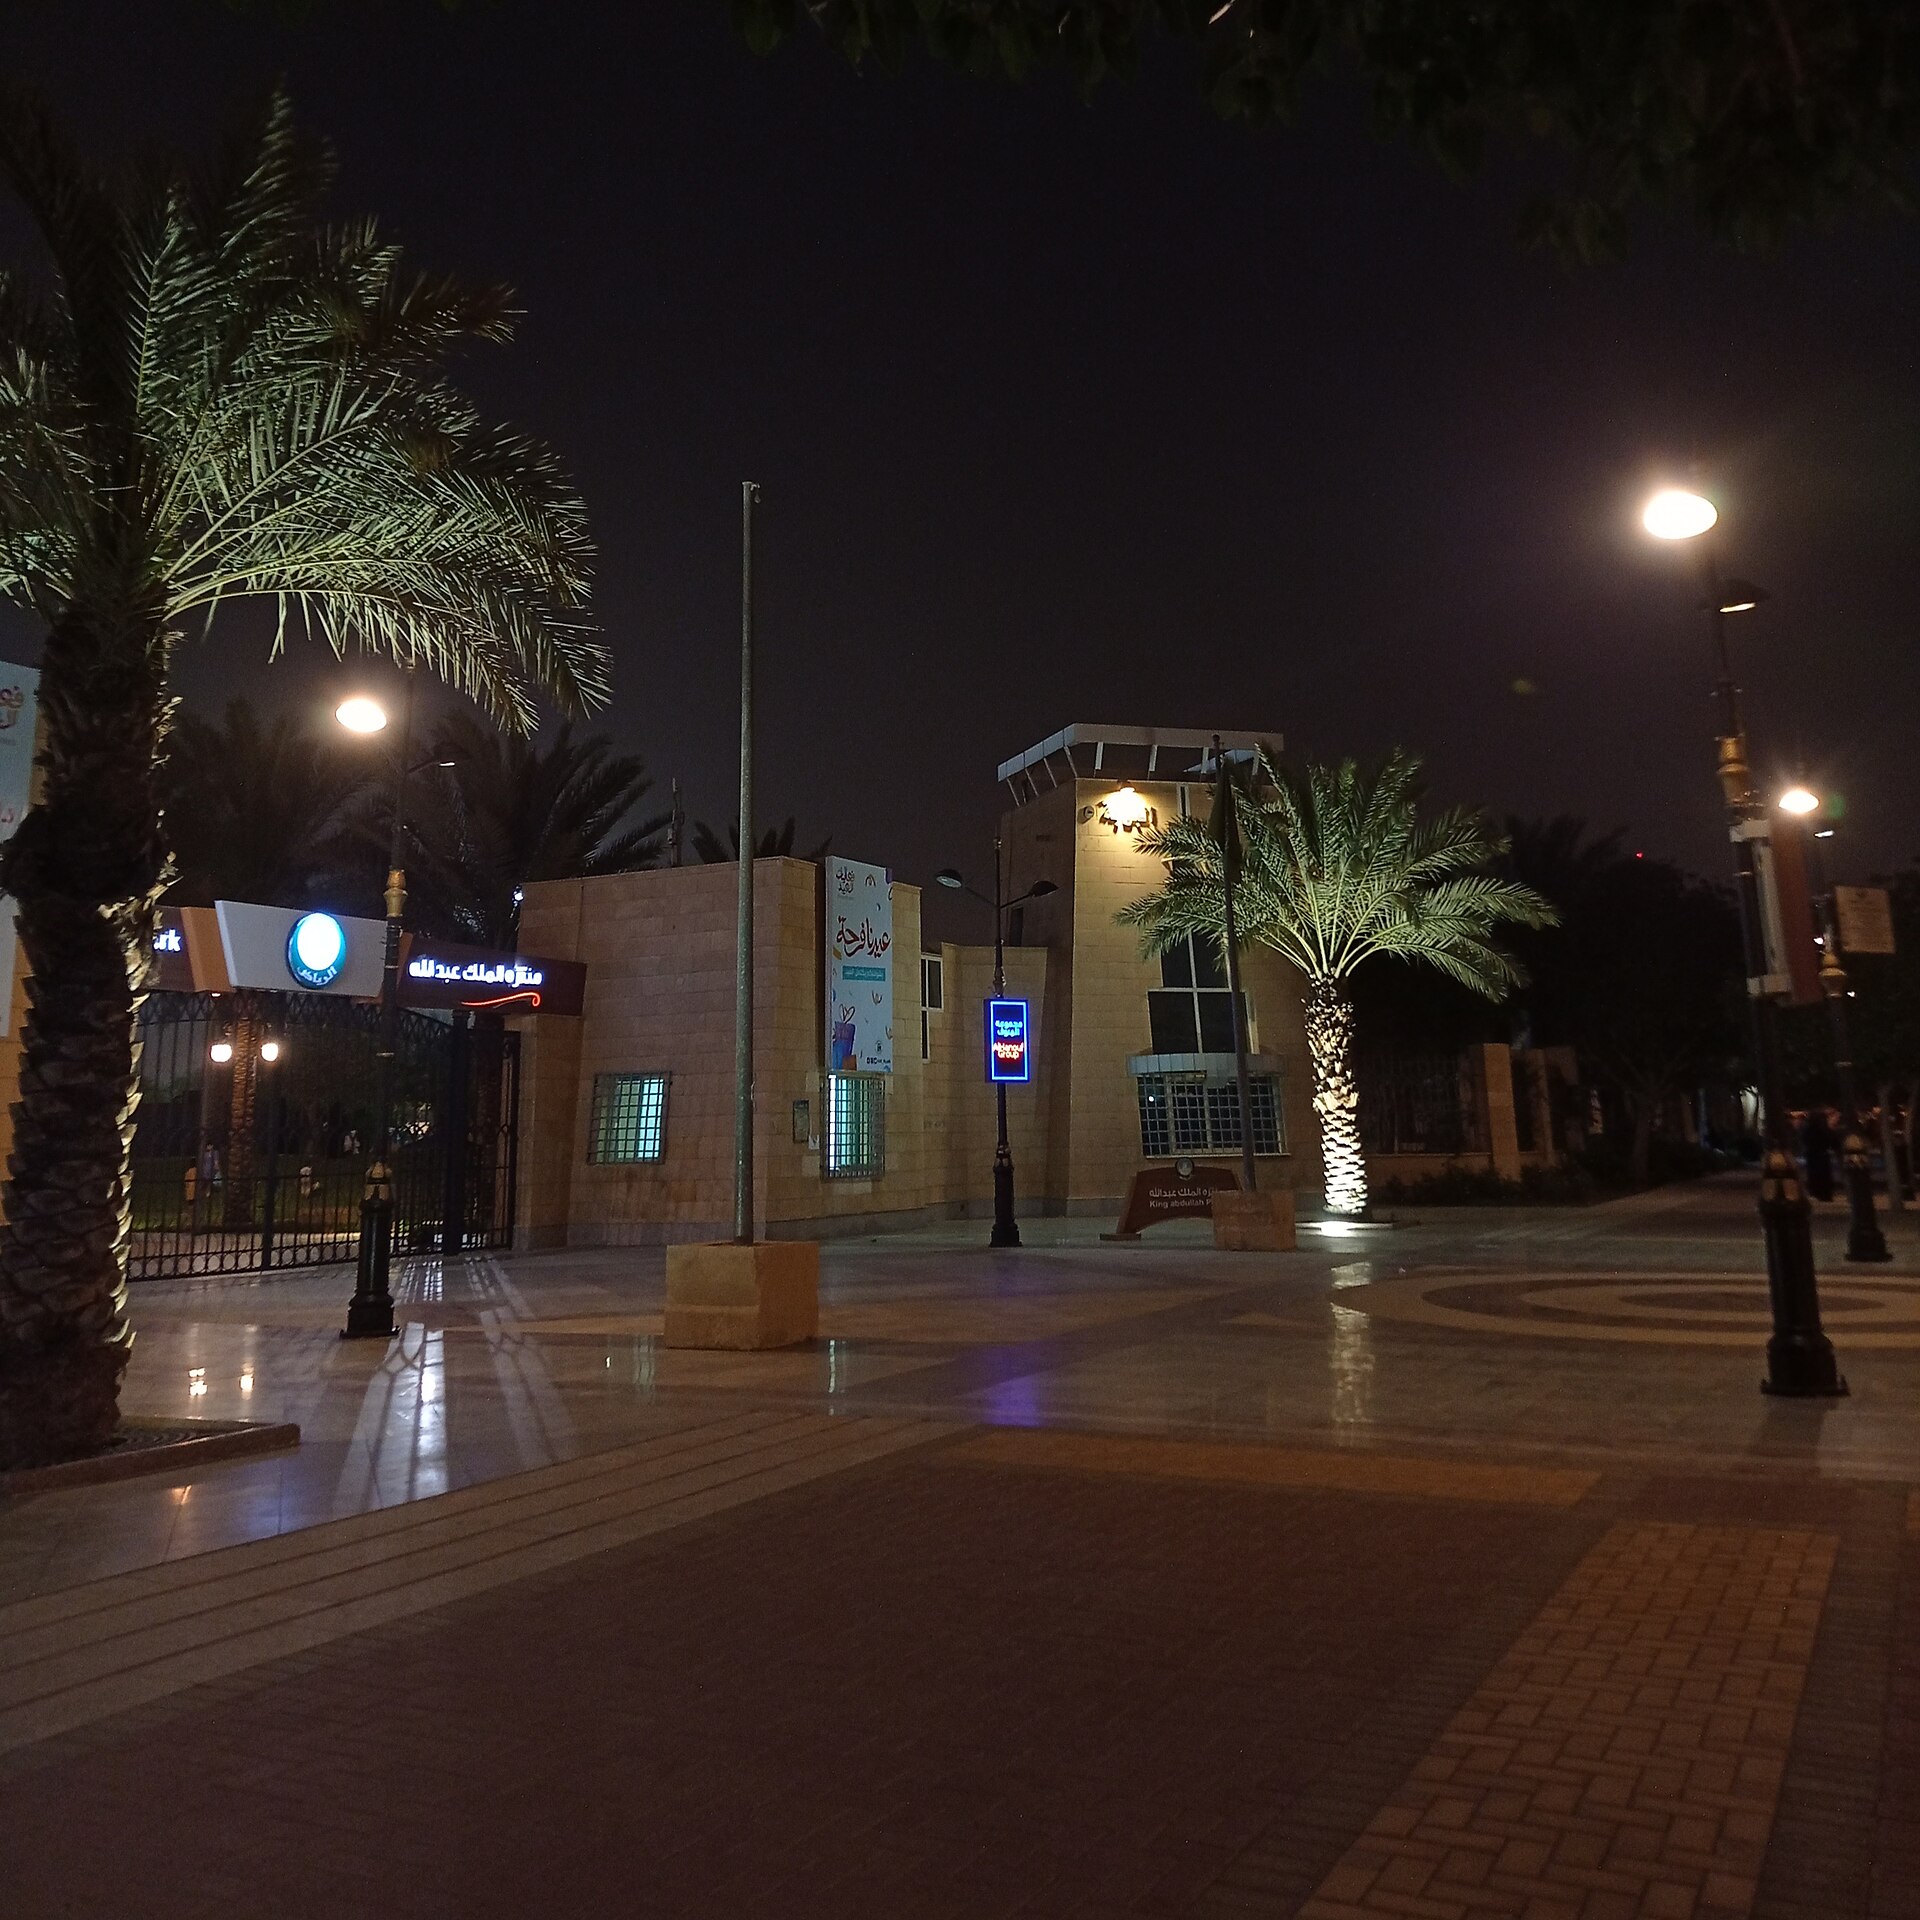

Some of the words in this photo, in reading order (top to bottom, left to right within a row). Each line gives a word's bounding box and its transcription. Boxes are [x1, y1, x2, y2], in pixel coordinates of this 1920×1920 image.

[836, 915, 866, 958] فرحة
[866, 917, 892, 958] عيدنا
[462, 963, 504, 984] الملك
[997, 1050, 1020, 1059] Group
[1149, 1187, 1177, 1198] عبدالله
[1177, 1187, 1202, 1197] الملك
[1149, 1200, 1169, 1209] King
